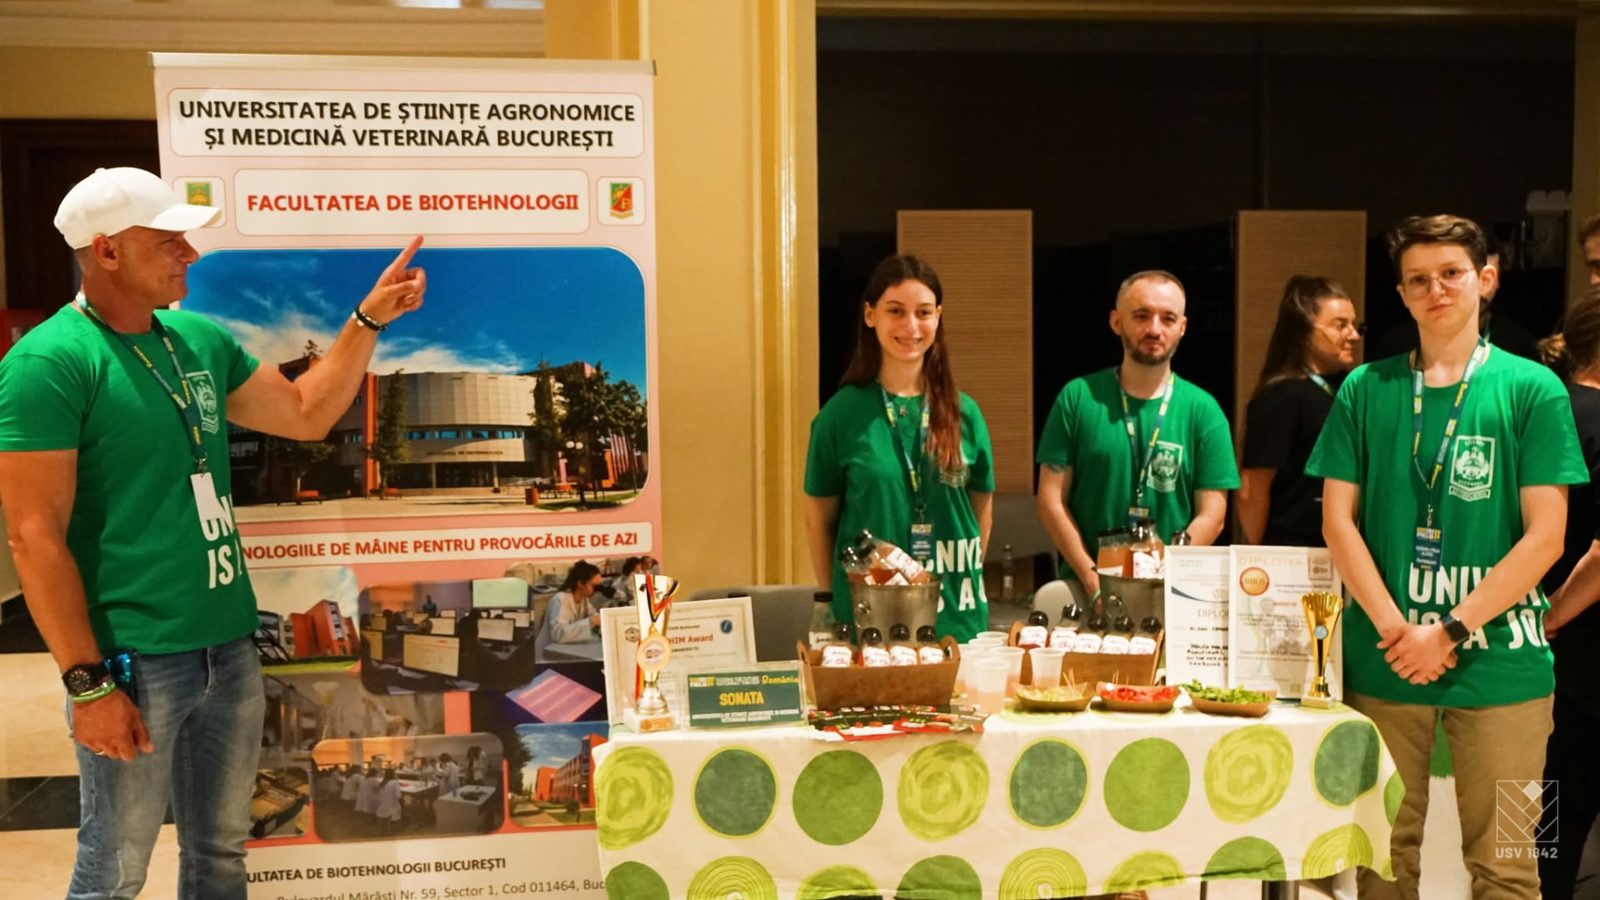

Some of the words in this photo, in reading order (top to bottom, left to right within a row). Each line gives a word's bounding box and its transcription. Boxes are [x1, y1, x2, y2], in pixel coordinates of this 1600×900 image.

[179, 99, 357, 120] UNIVERSITATEA
[363, 102, 392, 120] DE
[398, 102, 480, 124] ȘTIINȚE
[487, 103, 635, 122] AGRONOMICE
[204, 128, 225, 150] ȘI
[232, 125, 345, 147] MEDICINĂ
[353, 125, 489, 147] VETERINARĂ
[497, 129, 614, 152] BUCUREȘTI
[247, 195, 380, 212] FACULTATEA
[386, 195, 413, 211] DE
[419, 194, 579, 211] BIOTEHNOLOGII
[330, 541, 351, 557] DE
[355, 534, 408, 555] MÂINE
[413, 537, 475, 554] PENTRU
[480, 532, 585, 551] PROVOCĂRILE
[590, 533, 610, 548] DE
[614, 532, 638, 547] AZI
[208, 544, 235, 590] IS
[688, 632, 714, 644] Award
[719, 691, 765, 706] SONATA
[306, 867, 323, 880] DE
[327, 862, 431, 879] BIOTEHNOLOGII
[434, 857, 506, 872] BUCUREȘTI
[421, 887, 440, 900] 59,
[444, 886, 484, 898] Sector
[488, 885, 498, 896] 1,
[502, 882, 527, 894] Cod
[530, 880, 580, 893] 011464,
